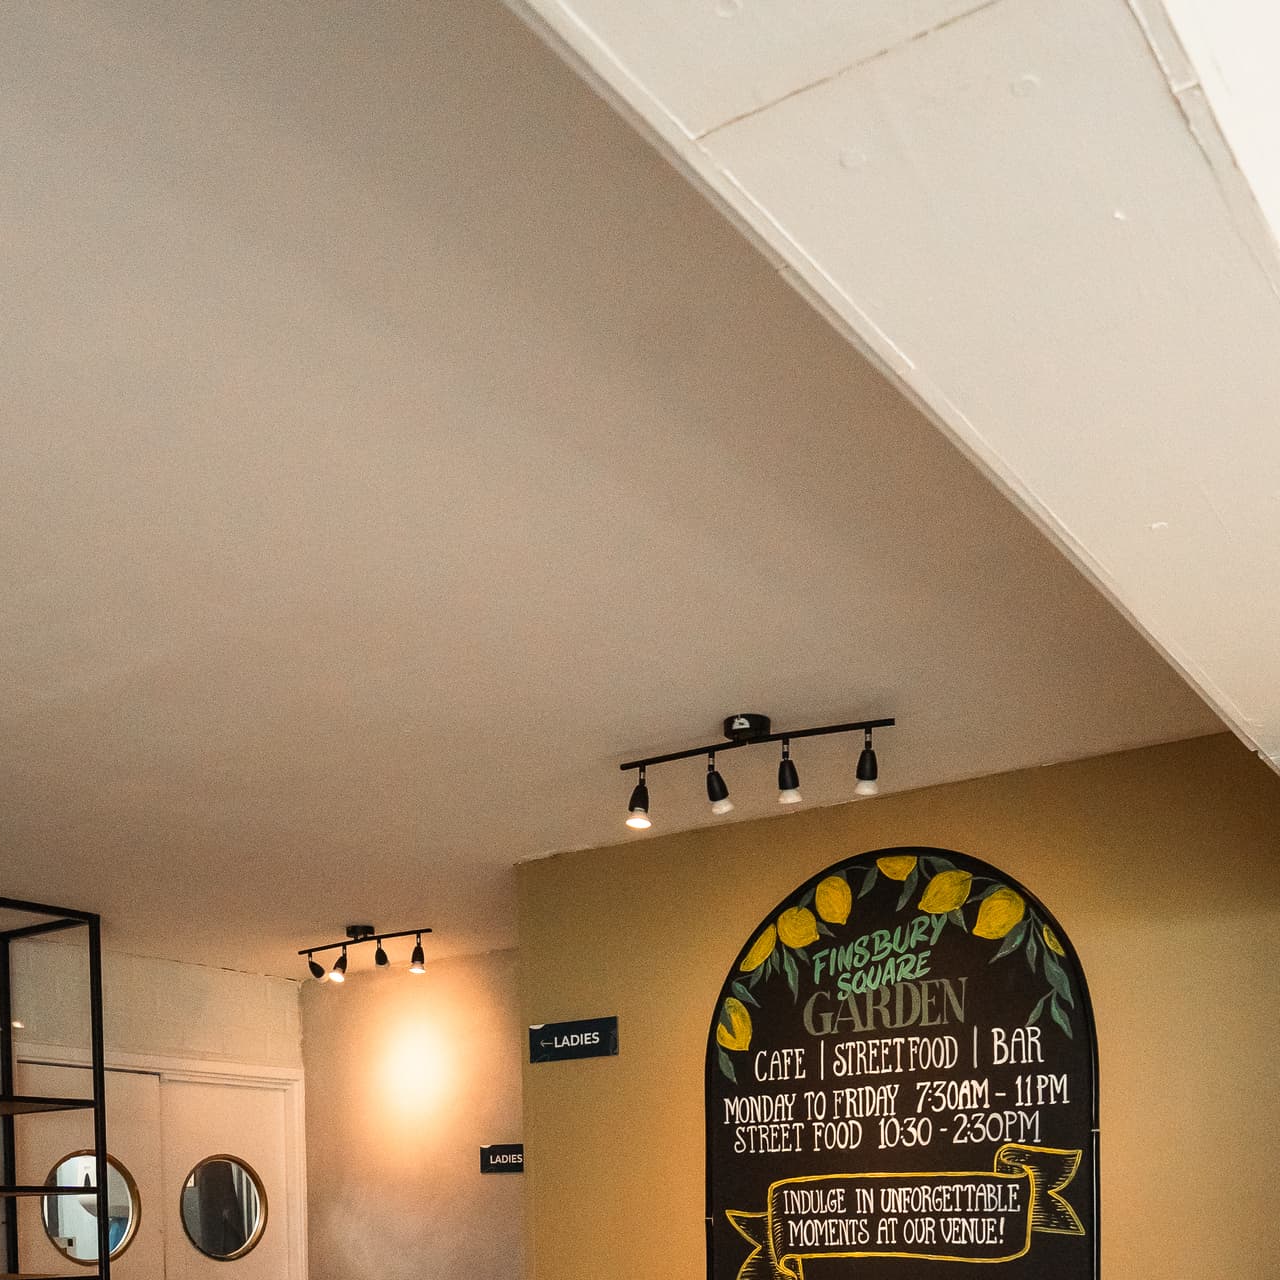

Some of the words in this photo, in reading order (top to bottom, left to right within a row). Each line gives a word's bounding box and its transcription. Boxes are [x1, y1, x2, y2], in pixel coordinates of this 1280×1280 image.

[812, 912, 949, 985] FINSBURY
[837, 950, 932, 1001] SQUARE
[803, 977, 968, 1036] GARDEN
[554, 1032, 600, 1049] LADIES
[754, 1048, 806, 1082] CAFE
[991, 1026, 1045, 1065] BAR
[723, 1093, 797, 1124] MONDAY
[804, 1091, 827, 1121] TO
[832, 1084, 900, 1120] FRIDAY
[916, 1078, 991, 1113] 7:30AM
[734, 1122, 805, 1153] STREET
[812, 1120, 863, 1151] FOOD
[878, 1116, 933, 1149] 10:30
[953, 1110, 1042, 1143] 2:30PM
[490, 1153, 523, 1164] LADIES
[783, 1188, 847, 1215] INDULGE
[856, 1188, 875, 1214] IN
[880, 1184, 1021, 1213] UNFORGETTABLE
[788, 1218, 870, 1247] MOMENTS
[876, 1217, 898, 1244] AT
[903, 1217, 937, 1244] OUR
[940, 1217, 1006, 1244] VENUE!
